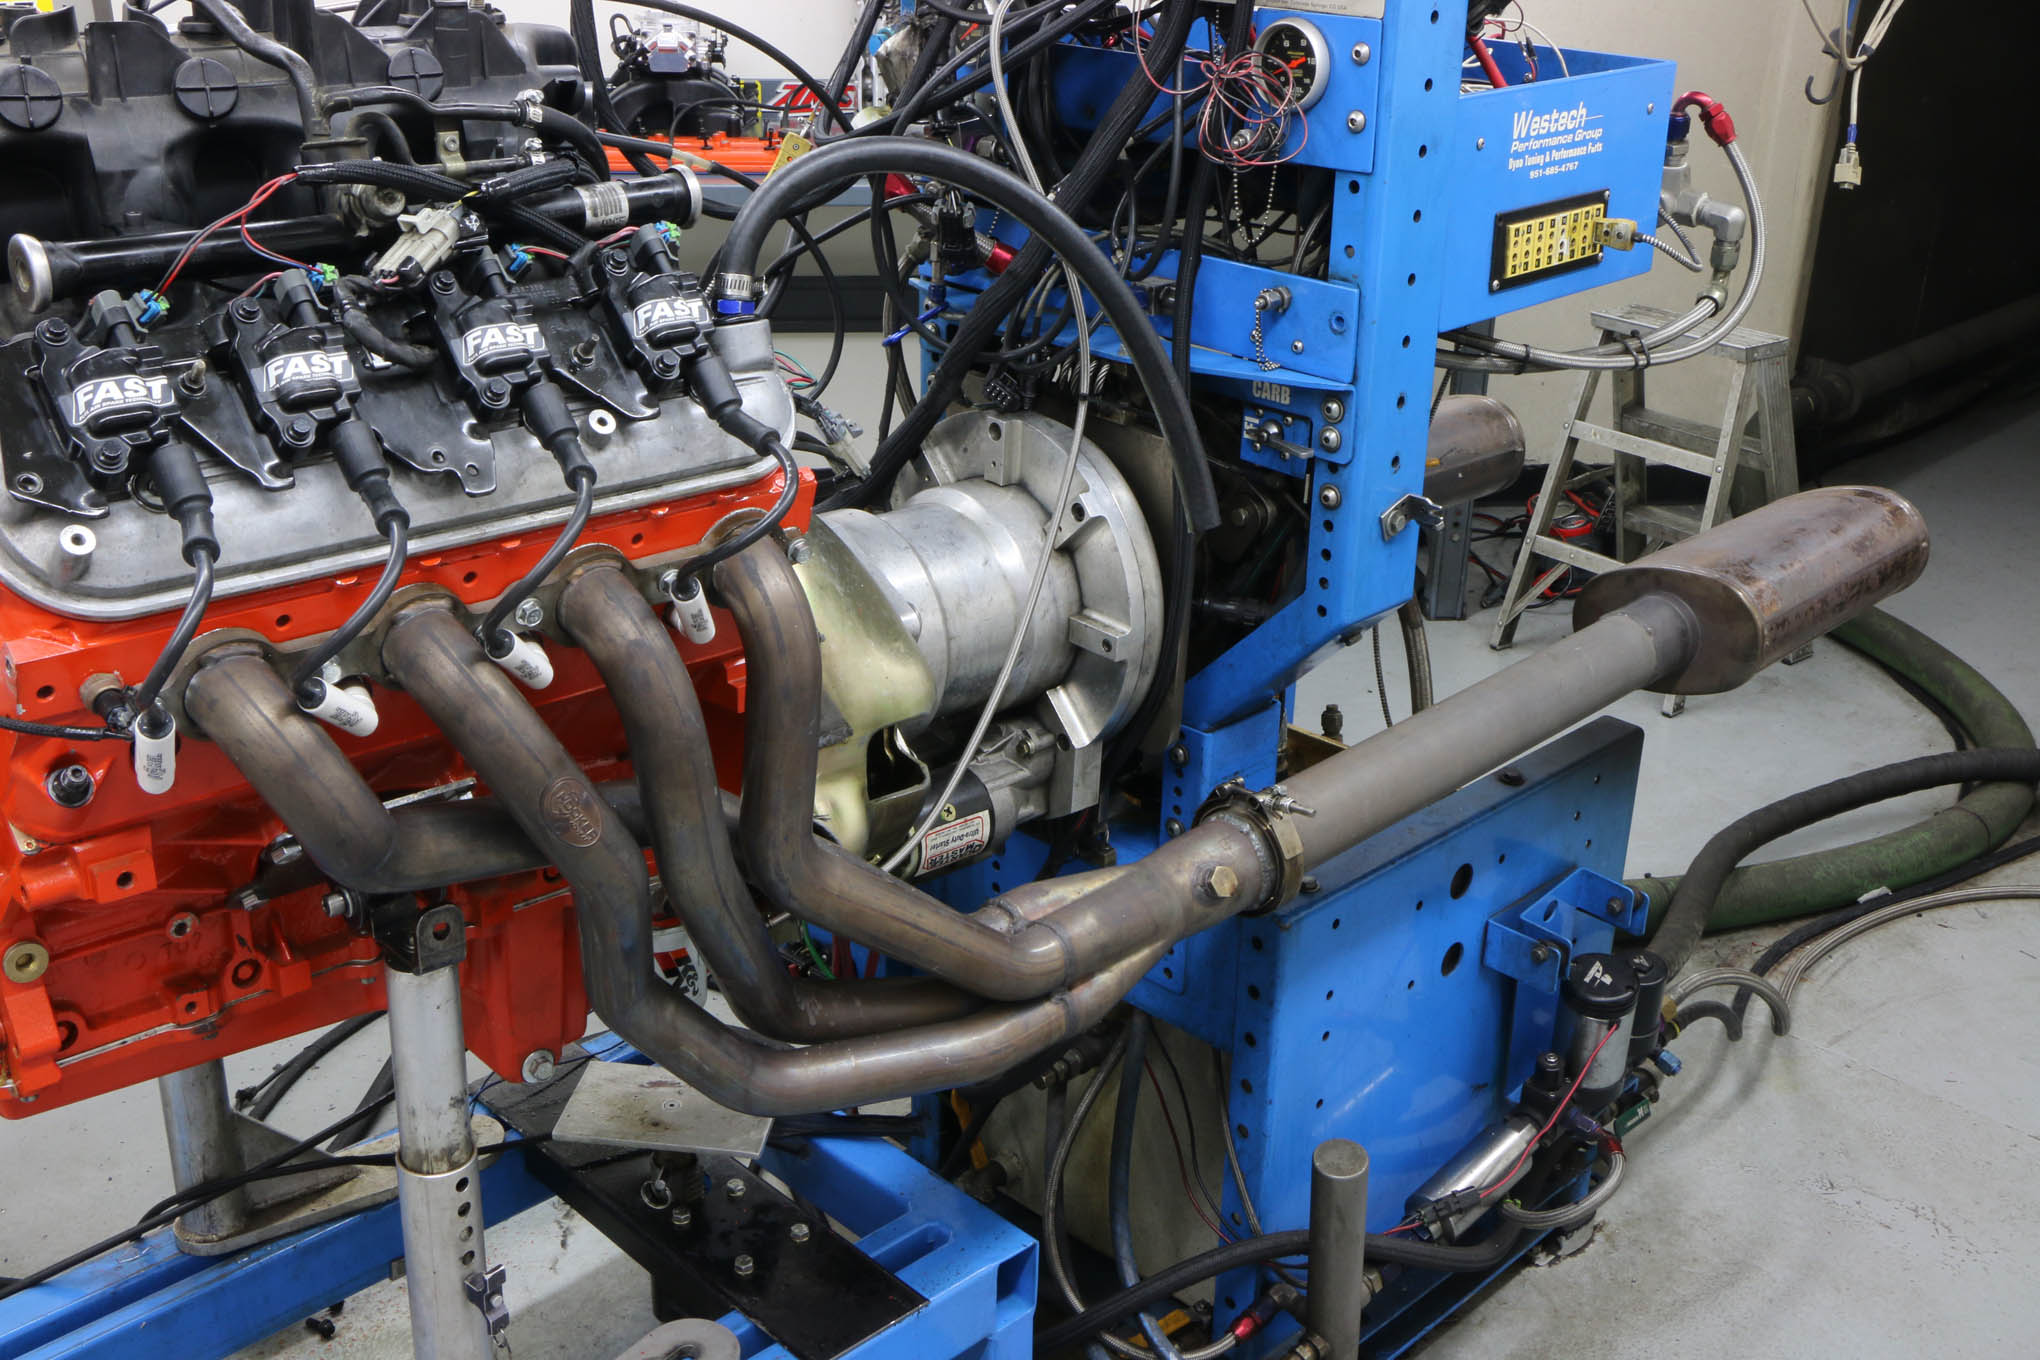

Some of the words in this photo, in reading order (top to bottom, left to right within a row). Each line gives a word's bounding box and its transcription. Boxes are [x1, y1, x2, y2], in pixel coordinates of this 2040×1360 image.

[1512, 101, 1590, 140] Westech
[1508, 158, 1524, 172] Dyno
[1524, 152, 1545, 167] Tuning
[1551, 146, 1587, 161] Performance
[1587, 142, 1603, 155] Parts
[1510, 134, 1574, 154] Performance
[1574, 128, 1603, 142] Group
[636, 299, 704, 330] FAST
[466, 325, 539, 358] FAST
[267, 354, 349, 388] FAST
[76, 378, 168, 416] FAST
[1252, 380, 1291, 405] CARB
